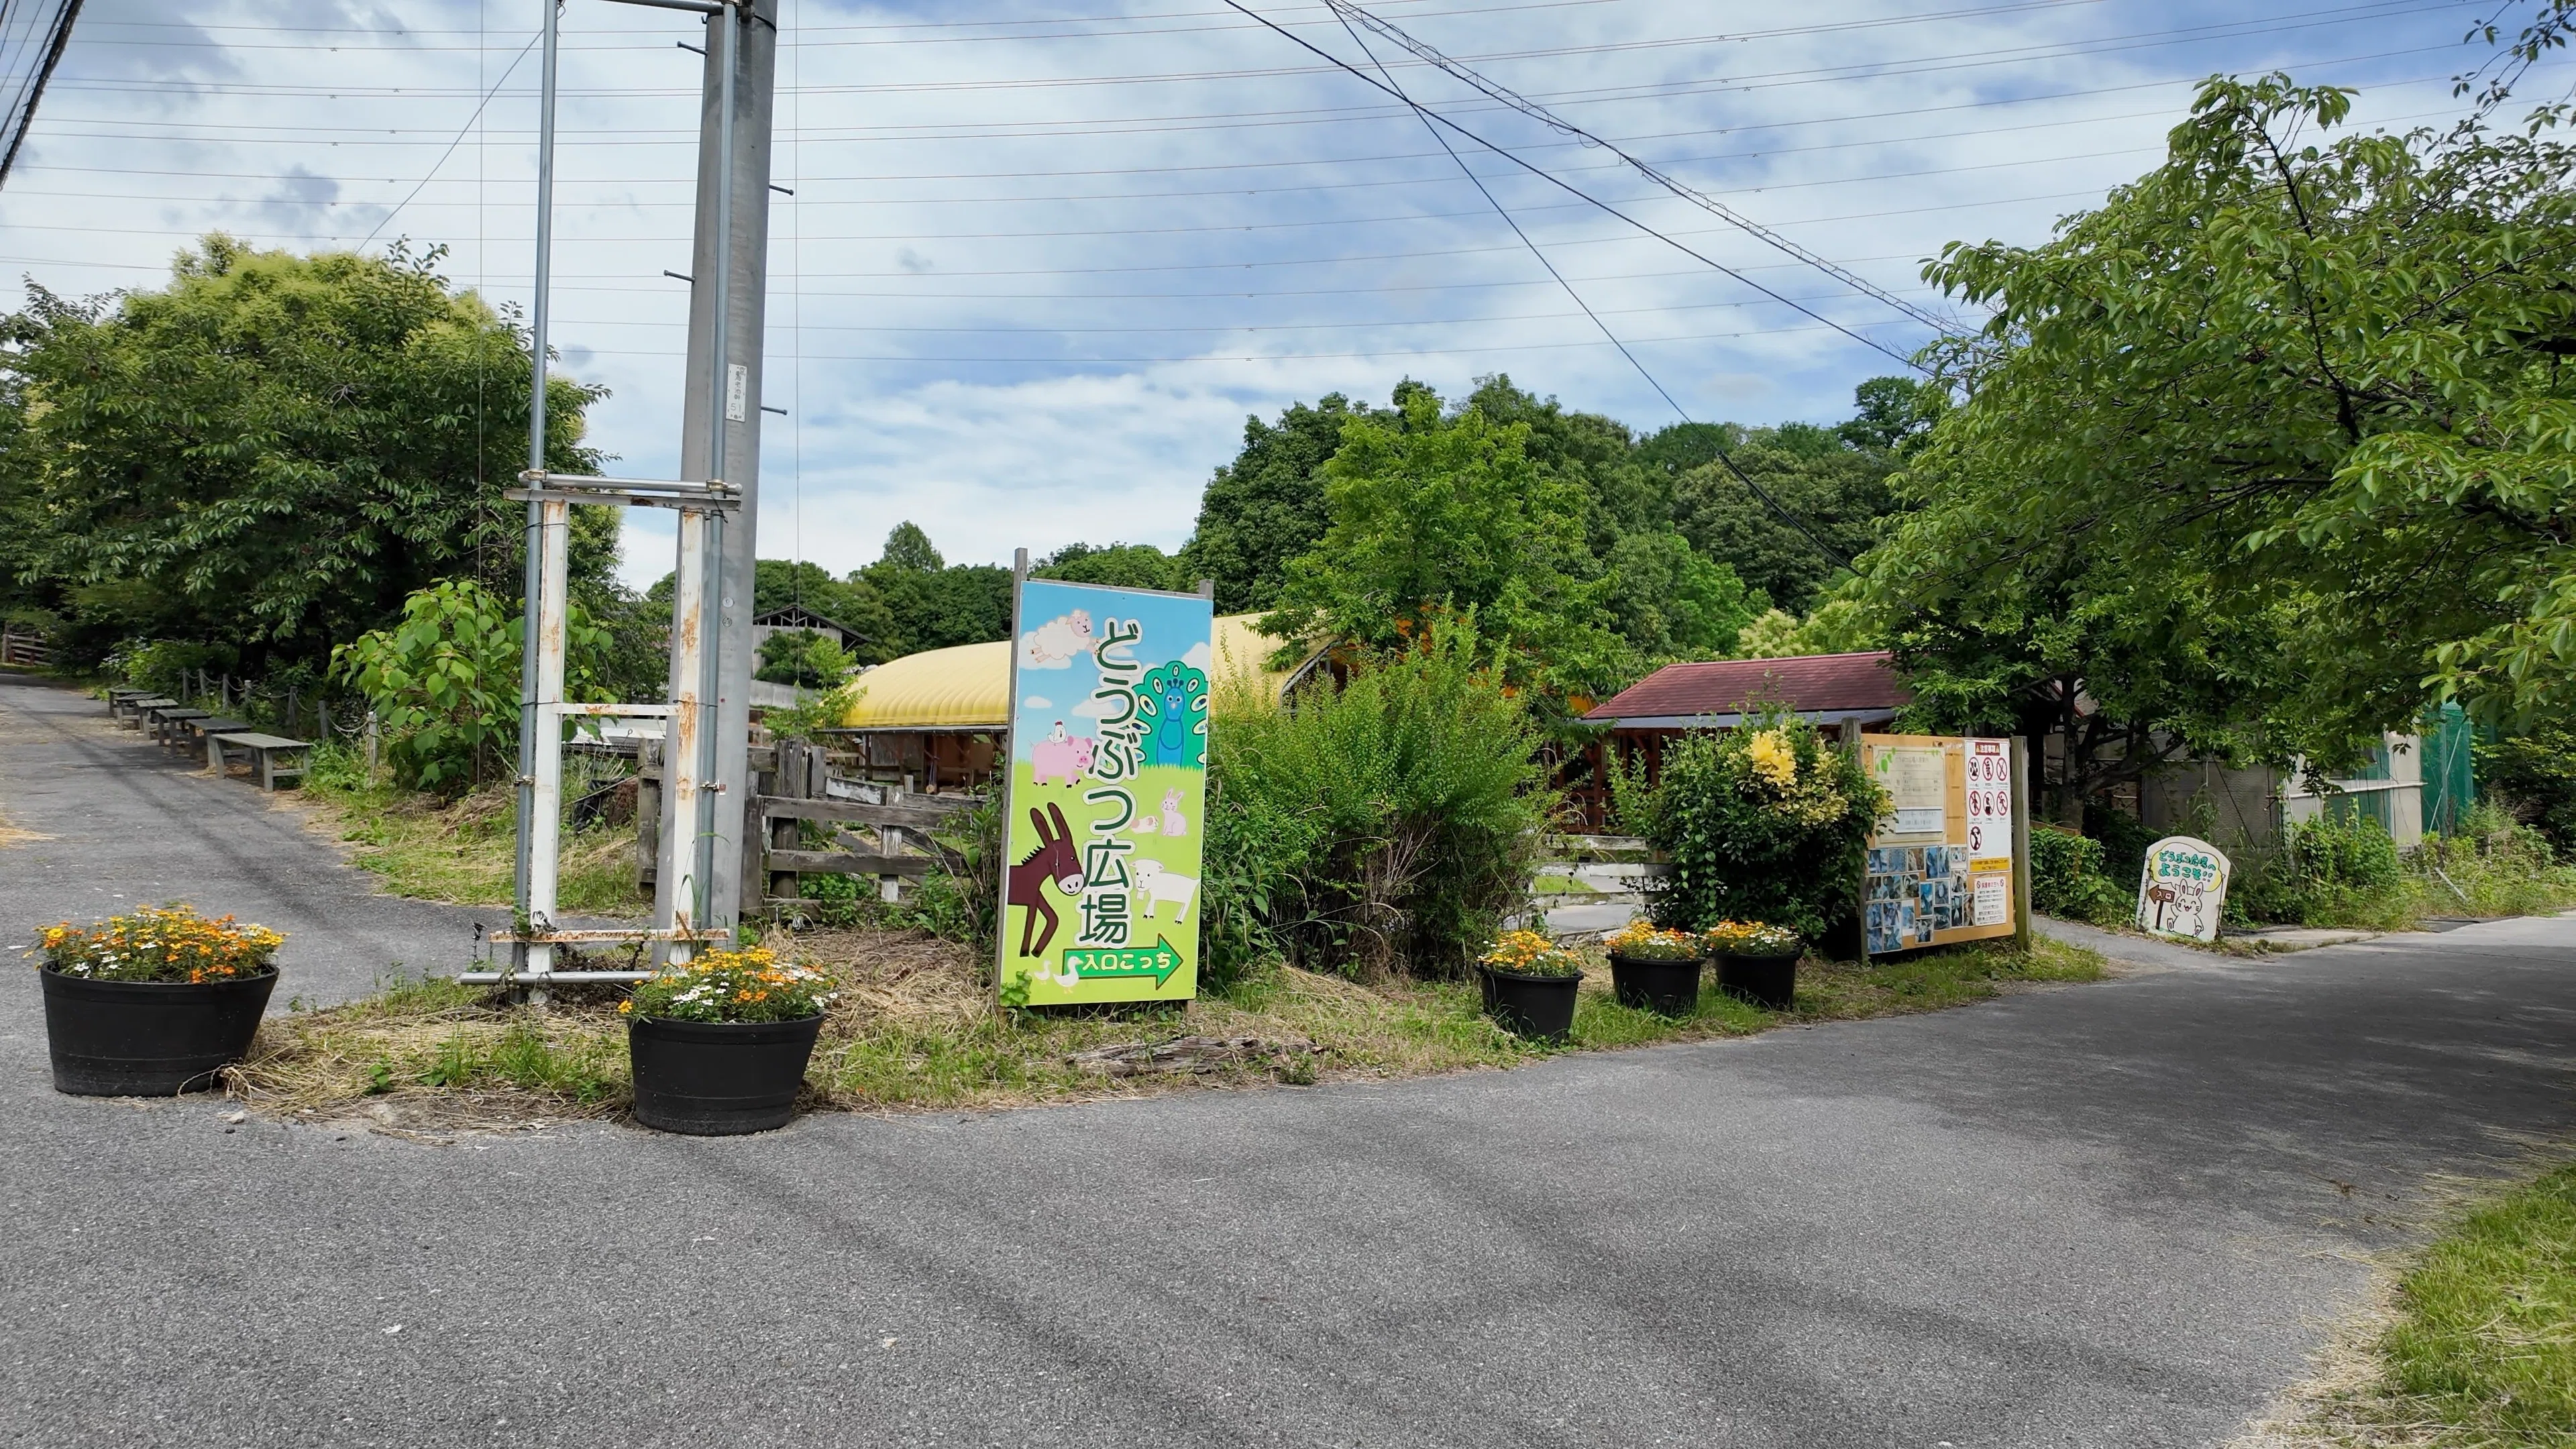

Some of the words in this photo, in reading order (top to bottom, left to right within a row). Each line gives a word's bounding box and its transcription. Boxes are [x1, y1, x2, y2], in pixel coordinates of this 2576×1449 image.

[1079, 620, 1140, 945] どうぶつ広場
[2159, 851, 2216, 871] どうぶつ広場へ
[2156, 890, 2171, 900] 入口
[1082, 952, 1171, 971] 入口こっち
